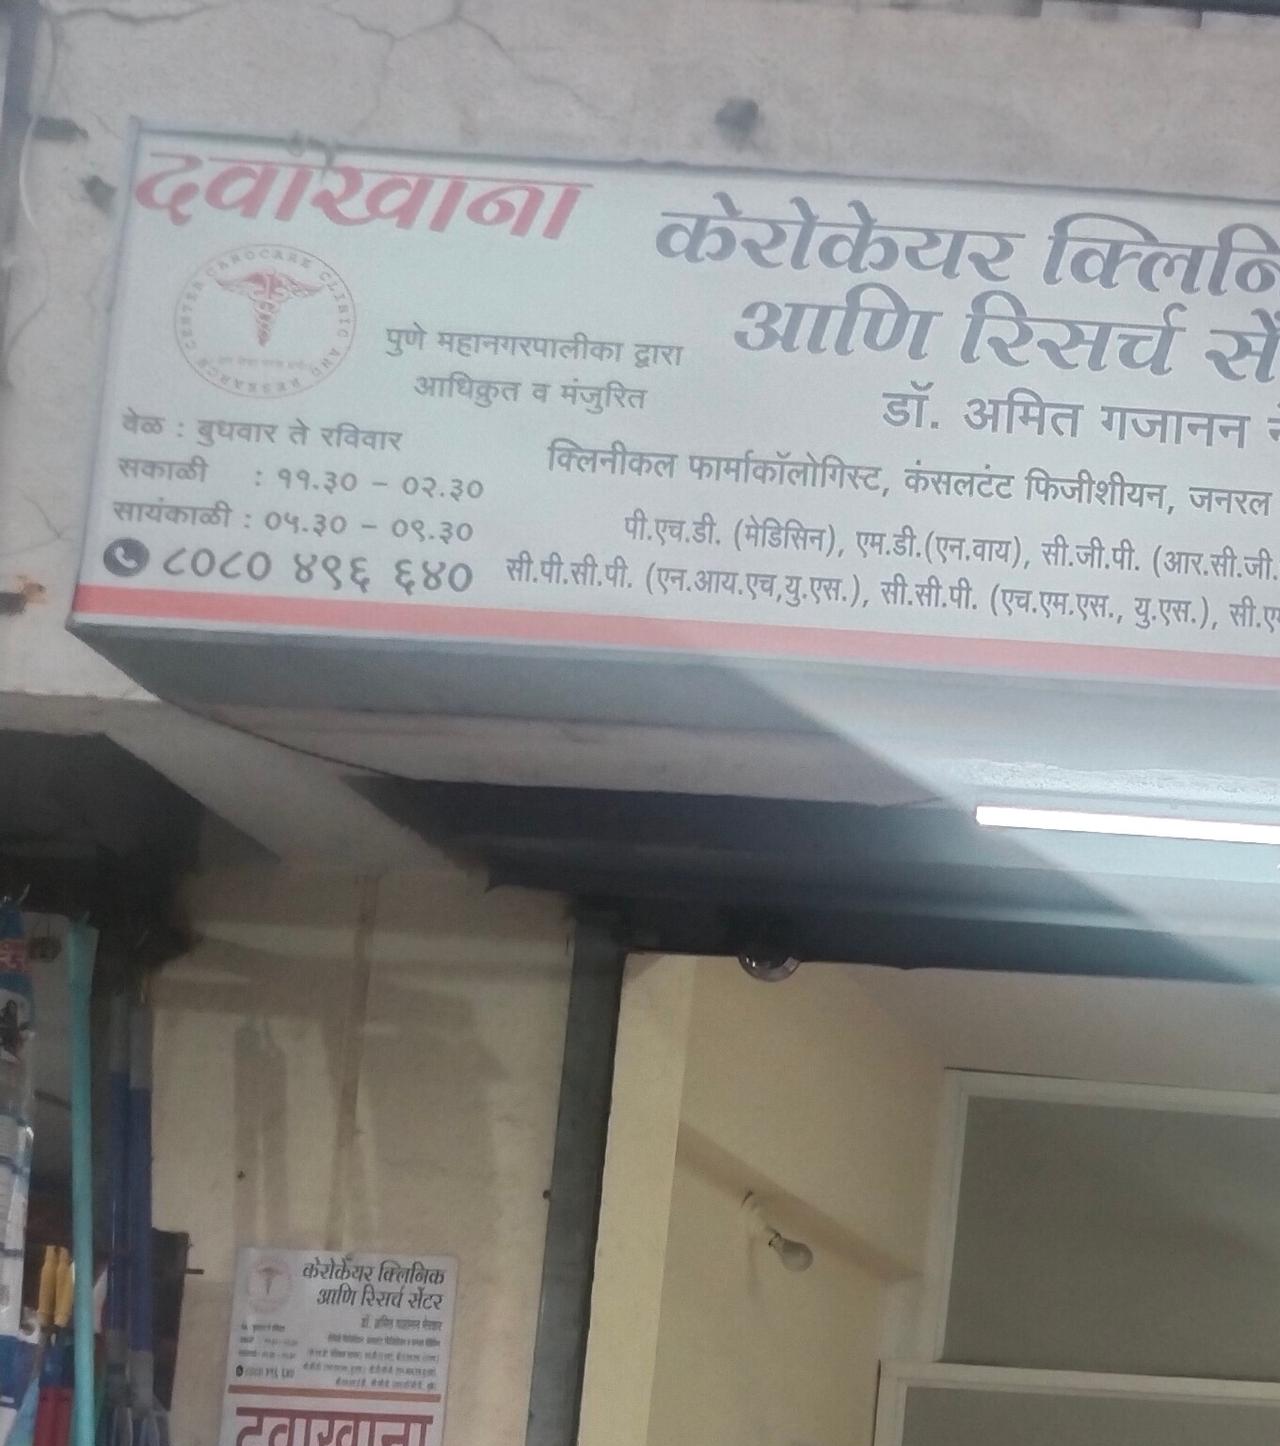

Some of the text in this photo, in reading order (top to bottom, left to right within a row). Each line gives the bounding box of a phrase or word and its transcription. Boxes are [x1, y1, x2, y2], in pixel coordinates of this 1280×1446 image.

[134, 151, 593, 240] दवाखाना
[656, 192, 1024, 282] केरोकेयर
[386, 322, 427, 356] पुणे
[634, 342, 683, 367] द्वारा
[734, 282, 942, 359] आणि
[959, 290, 1186, 376] रिसर्च
[122, 408, 403, 452] वेळ बुधवार ते रविवार
[882, 381, 940, 429] डॉ.
[964, 388, 1084, 439] अमित
[1101, 405, 1250, 449] गजानन
[118, 456, 484, 501] सकाळी ११.३० ०२.३०
[113, 497, 473, 544] सायंकाळी ०५.३० ०९.३०
[163, 547, 473, 595] ८०८० ४९६ ६४०
